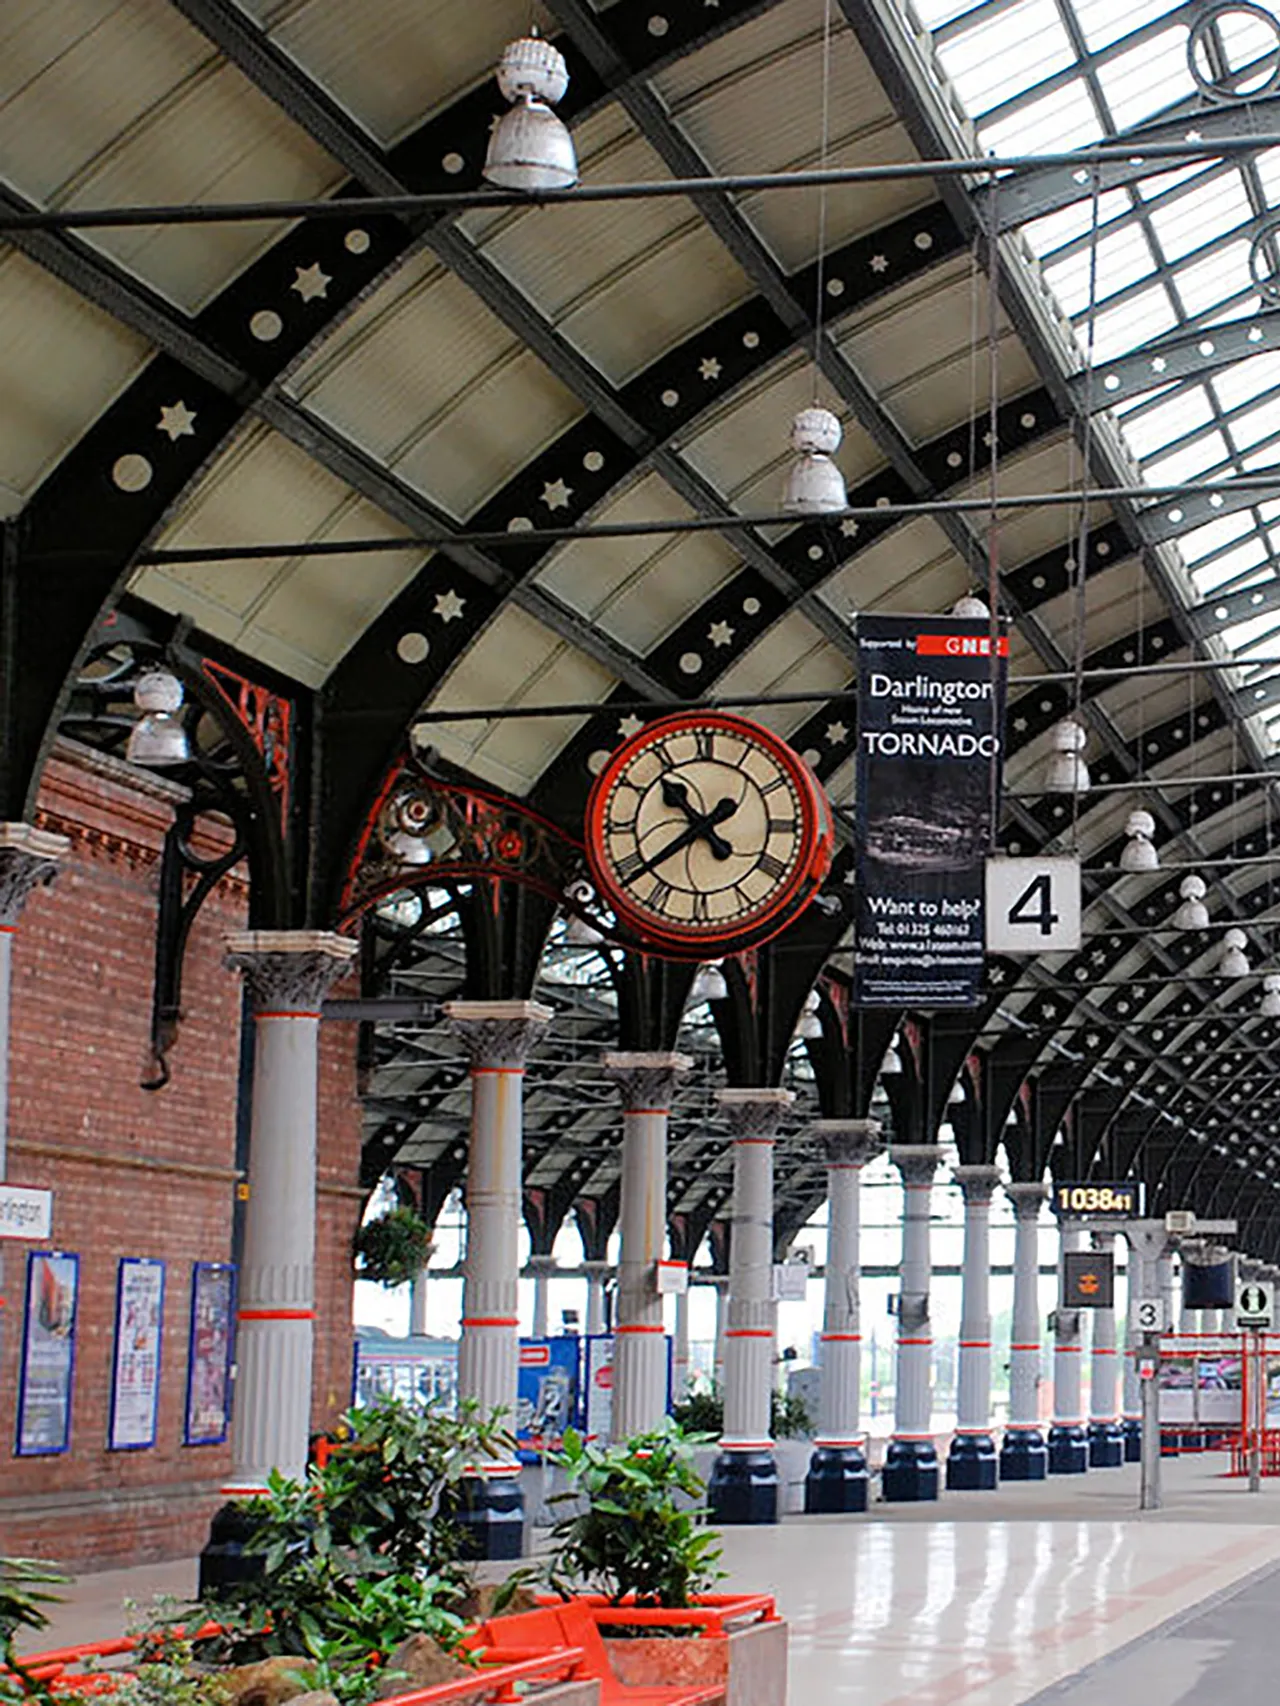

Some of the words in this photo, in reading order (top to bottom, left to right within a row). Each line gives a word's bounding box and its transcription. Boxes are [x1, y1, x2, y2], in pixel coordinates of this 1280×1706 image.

[871, 674, 994, 705] Darlington
[862, 732, 1000, 757] TORNADO
[867, 897, 916, 915] Want
[919, 901, 938, 916] to
[1008, 873, 1058, 936] 4
[1139, 1303, 1157, 1327] 3
